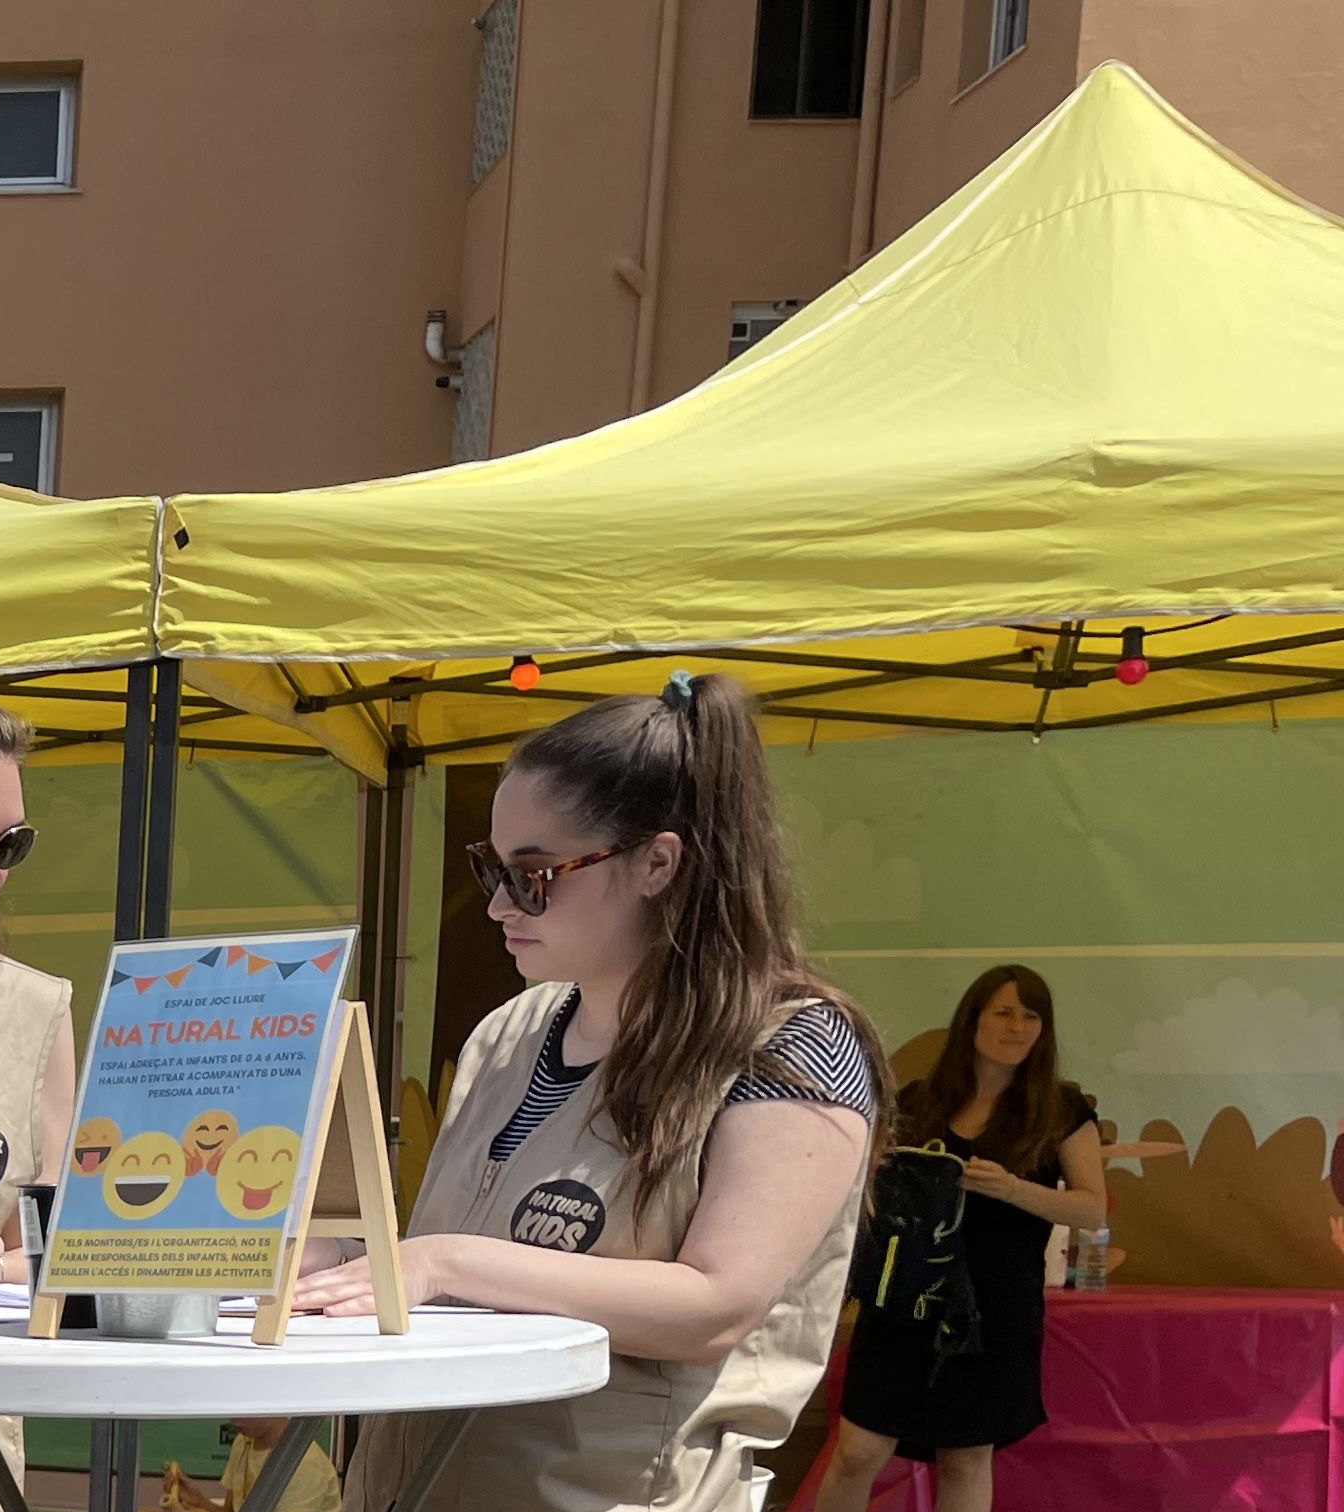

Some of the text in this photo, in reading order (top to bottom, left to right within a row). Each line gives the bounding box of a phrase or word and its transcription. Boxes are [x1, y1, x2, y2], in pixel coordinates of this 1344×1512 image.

[164, 994, 267, 1009] ESPAI DE JOC LLIURE
[102, 1013, 317, 1048] NATURAL KIDS
[100, 1060, 128, 1071] ESPAI
[129, 1057, 175, 1070] ADREÇAT
[175, 1057, 183, 1066] A
[185, 1055, 228, 1066] INFANTS
[230, 1054, 243, 1063] DE
[253, 1053, 262, 1062] A
[264, 1053, 271, 1062] 6
[98, 1067, 302, 1086] HAURAN D'ENTRAR ACOMPANYATS D'UNA
[147, 1088, 193, 1099] PERSONA
[528, 1189, 599, 1221] NATURAL
[514, 1208, 587, 1252] KIDS
[84, 1237, 150, 1248] MONITORS/ES
[241, 1237, 257, 1247] NO
[258, 1237, 271, 1247] ES
[59, 1252, 89, 1262] FARAN
[90, 1252, 160, 1262] RESPONSABLES
[162, 1252, 185, 1262] DELS
[231, 1250, 268, 1262] NOMÉS
[50, 1267, 90, 1277] REGULEN
[91, 1265, 130, 1277] L'ACCÉS
[136, 1267, 193, 1278] DINAMITZEN
[195, 1267, 212, 1277] LES
[214, 1267, 273, 1278] ACTIVITATS
